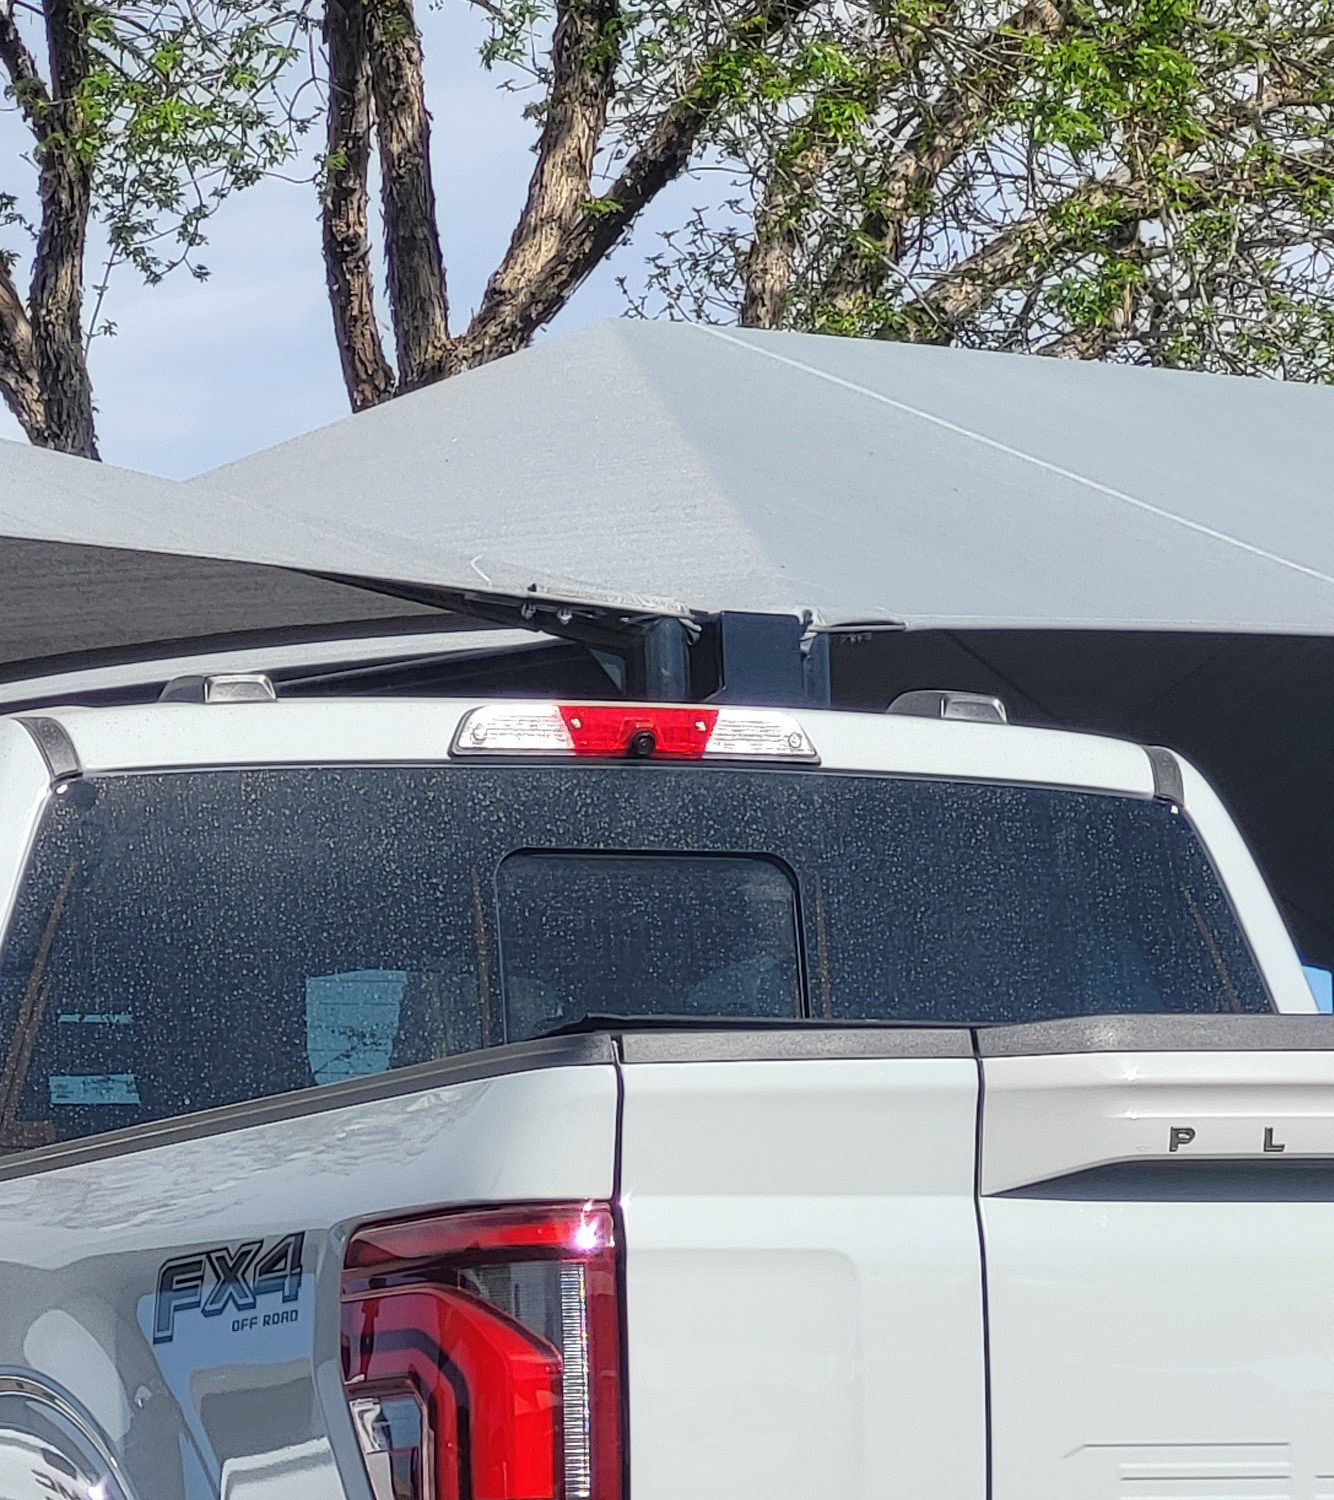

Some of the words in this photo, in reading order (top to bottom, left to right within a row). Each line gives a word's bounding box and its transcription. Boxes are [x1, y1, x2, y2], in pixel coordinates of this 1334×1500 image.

[153, 1231, 306, 1345] FX4
[231, 1314, 257, 1332] OFF
[263, 1309, 298, 1327] ROAD
